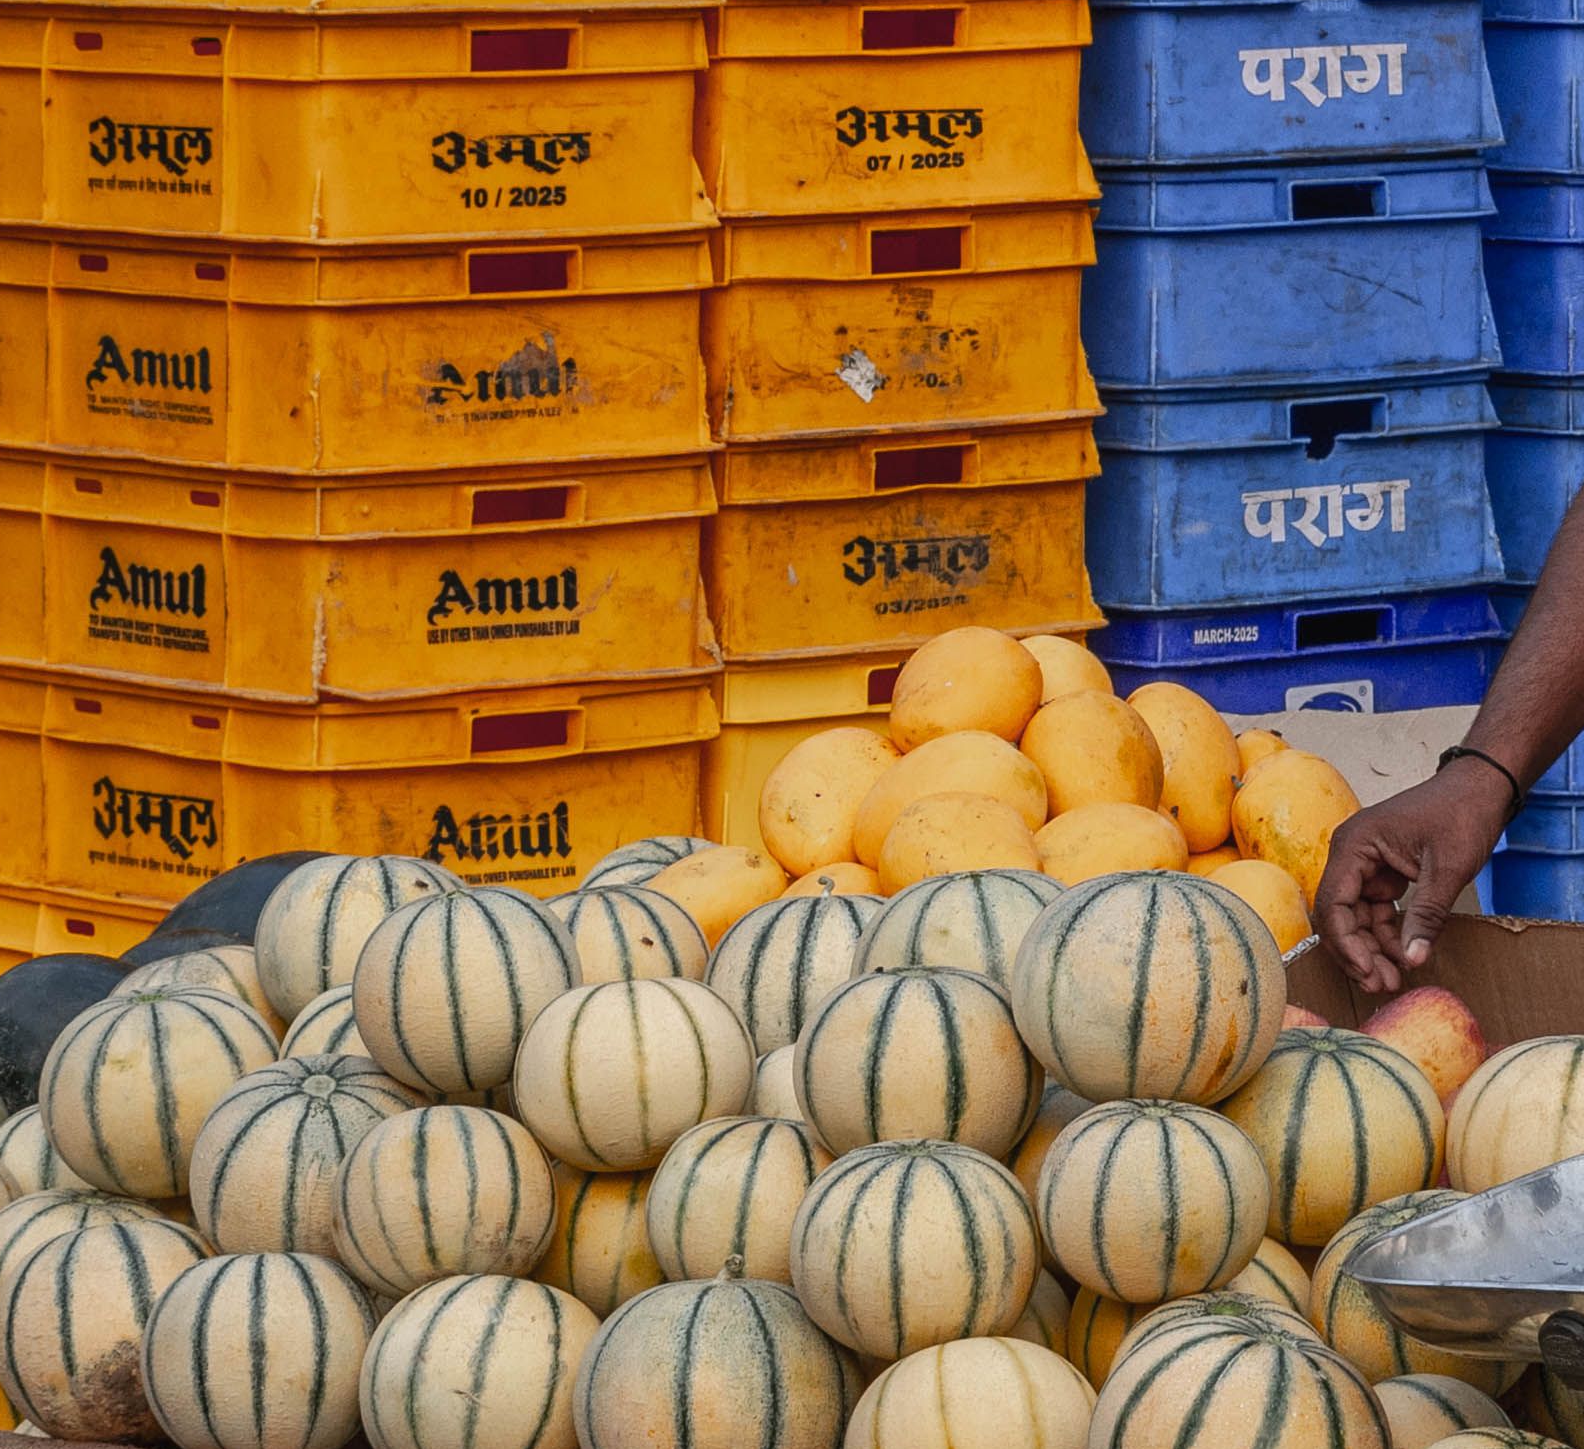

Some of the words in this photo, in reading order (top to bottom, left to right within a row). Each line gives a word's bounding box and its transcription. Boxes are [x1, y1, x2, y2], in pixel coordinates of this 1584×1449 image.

[1239, 43, 1407, 108] पराग
[88, 115, 214, 178] अमूल
[431, 131, 593, 176] अमूल
[835, 106, 984, 150] अमूल
[866, 155, 892, 172] 07
[911, 151, 966, 170] 2025
[461, 187, 489, 209] 10
[509, 185, 567, 208] 2025
[86, 335, 213, 395] Amul
[1242, 479, 1410, 548] पराग
[90, 546, 207, 618] Amul
[843, 535, 992, 587] अमूल
[427, 565, 581, 626] Amul
[1193, 625, 1259, 649] MARCH-2025
[93, 777, 218, 861] अमूल
[420, 800, 574, 864] Amul
